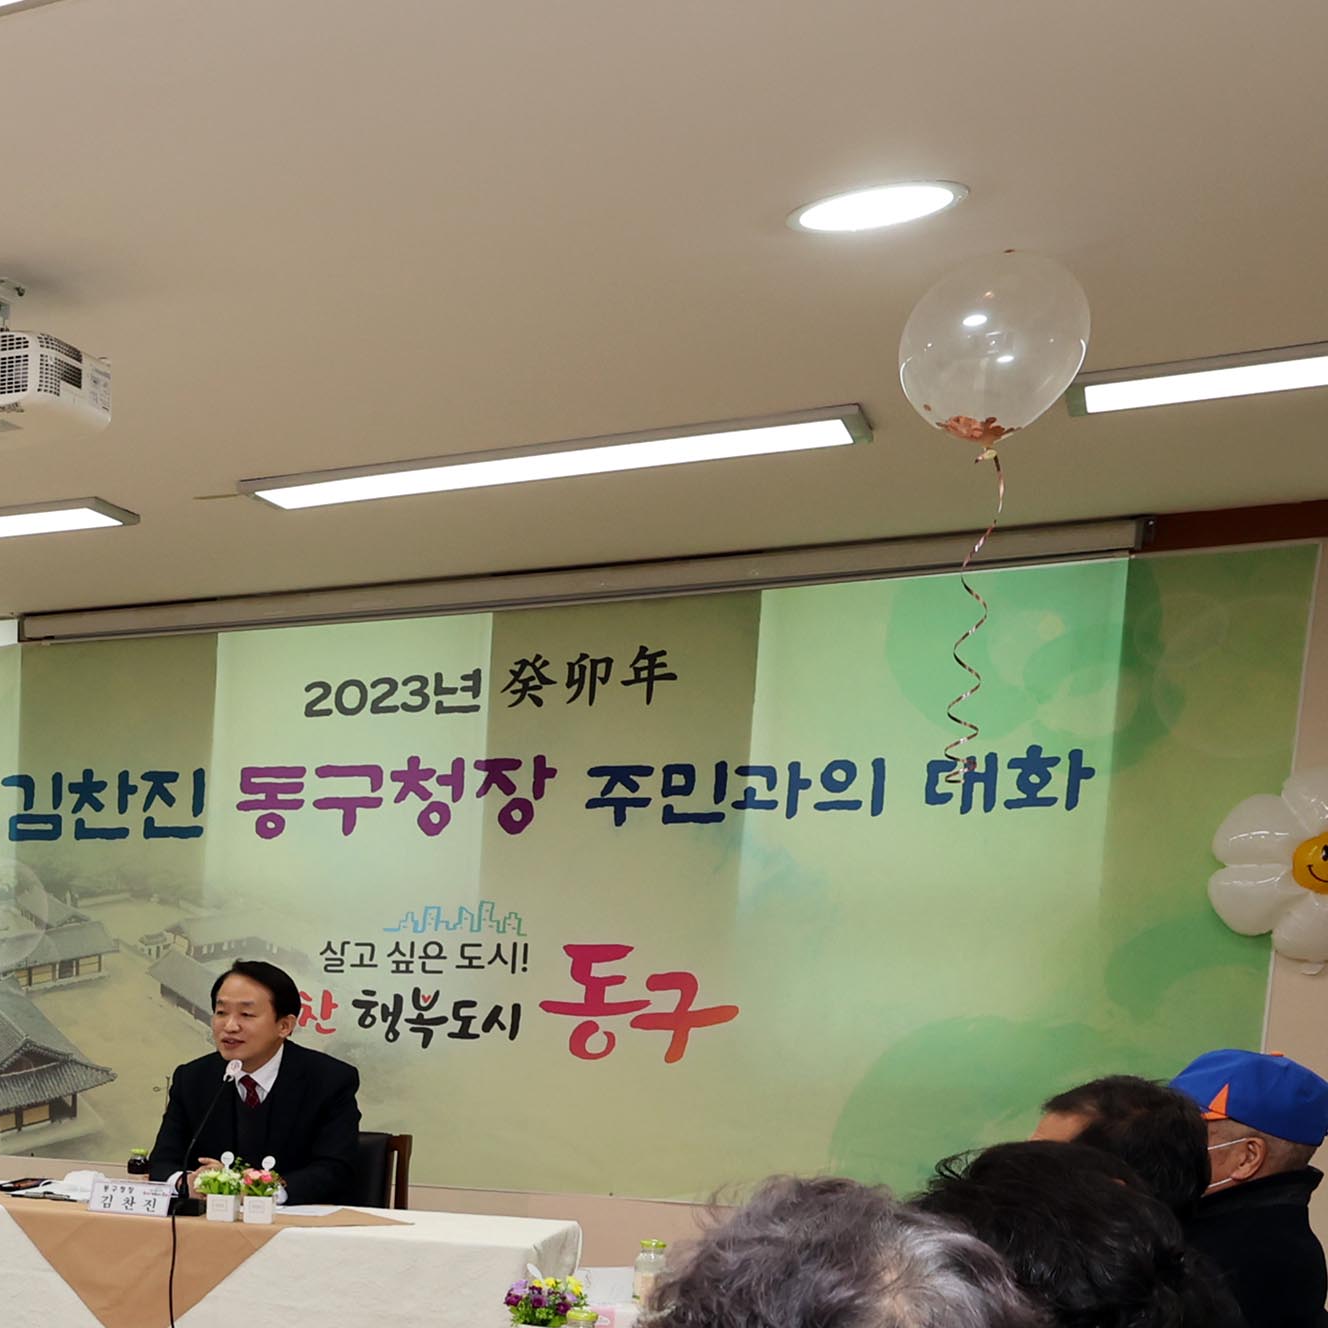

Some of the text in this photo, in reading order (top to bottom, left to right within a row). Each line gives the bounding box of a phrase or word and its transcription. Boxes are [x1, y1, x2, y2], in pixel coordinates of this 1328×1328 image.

[304, 645, 678, 718] 2023년 癸卯年
[0, 744, 1096, 841] 김찬진 동구청장 주민과의 대화
[319, 940, 529, 975] 살고 싶은 도시!
[351, 987, 522, 1049] 행복도시
[538, 943, 740, 1064] 동구
